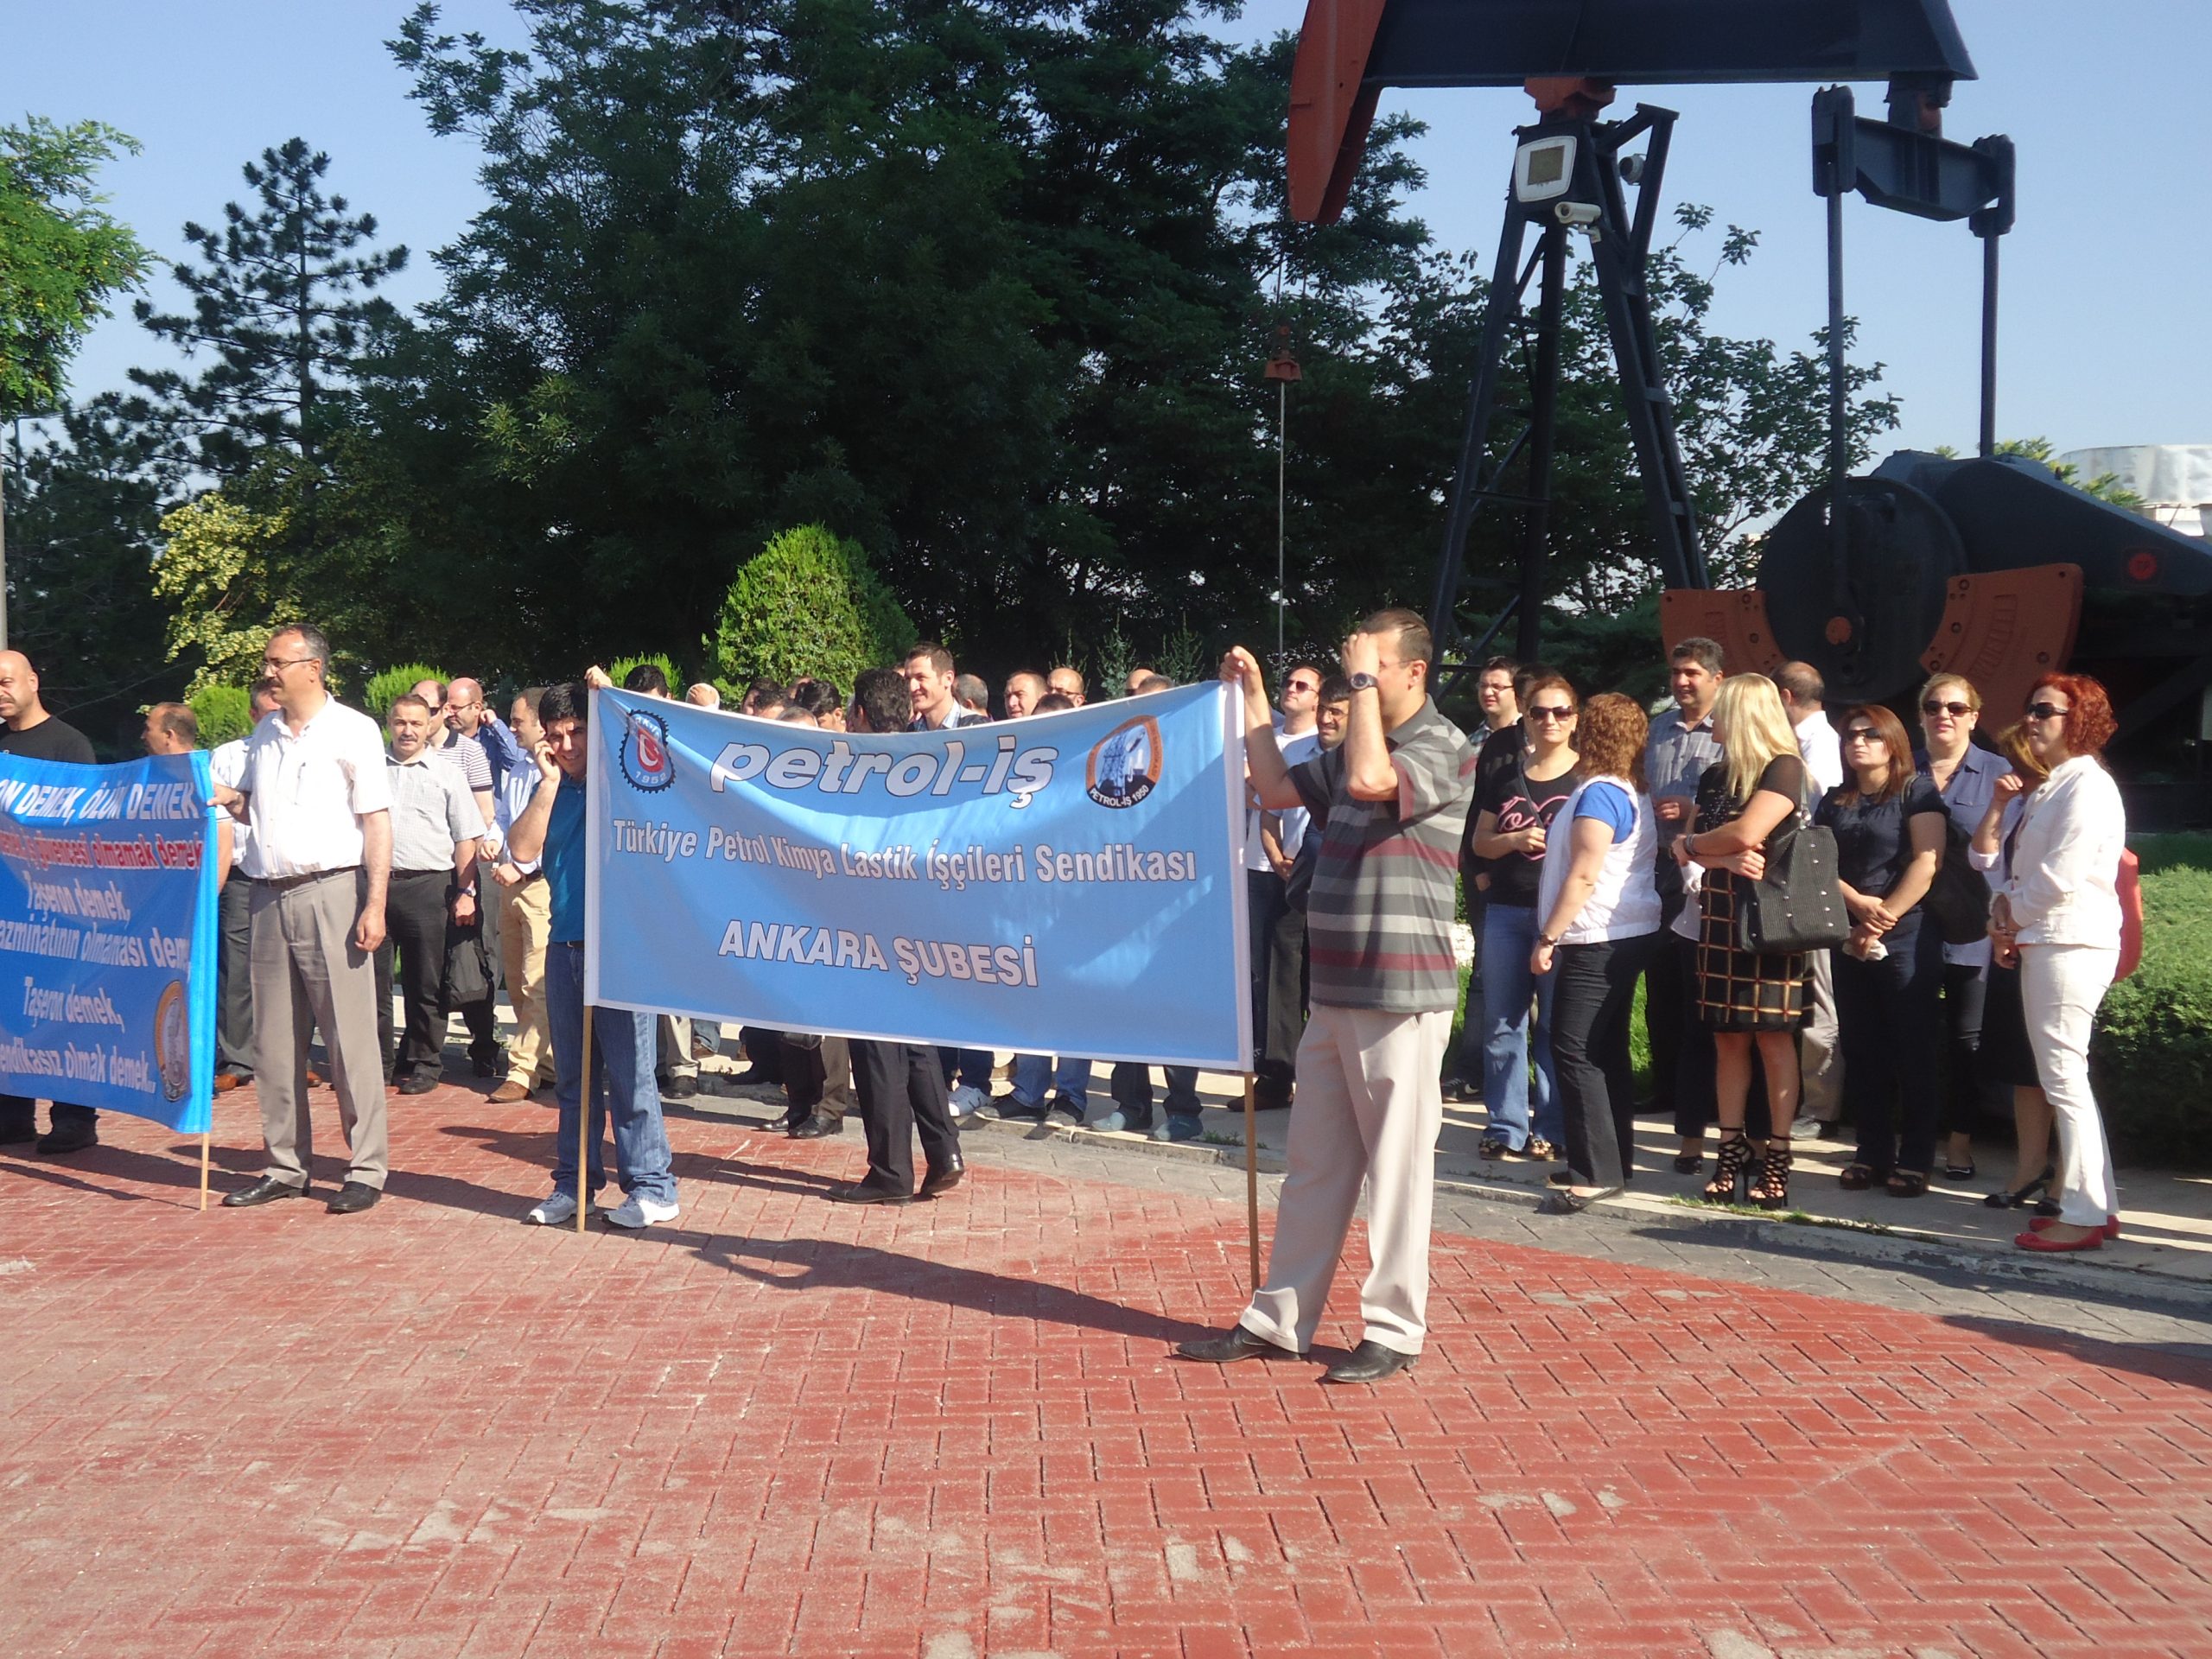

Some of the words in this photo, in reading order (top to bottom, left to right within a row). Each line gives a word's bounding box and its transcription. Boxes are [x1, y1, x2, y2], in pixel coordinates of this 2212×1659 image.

[710, 734, 1058, 809] petrol-iş
[1132, 785, 1149, 802] 1950
[126, 782, 200, 819] DEMEK
[91, 832, 162, 870] olmamak
[613, 818, 698, 862] Türkiye
[704, 826, 771, 866] Petrol
[769, 836, 836, 880] Kimya
[840, 842, 918, 882] Lastik
[926, 838, 1026, 891] İşçileri
[1036, 842, 1197, 883] Sendikası
[22, 870, 78, 922] Taşeron
[74, 878, 130, 930] demek,
[80, 922, 148, 967] olmaması
[717, 918, 889, 972] ANKARA
[893, 935, 1039, 987] ŞUBESİ
[23, 976, 65, 1027] Taşeron
[66, 983, 125, 1034] demek,
[64, 1042, 106, 1084] olmak
